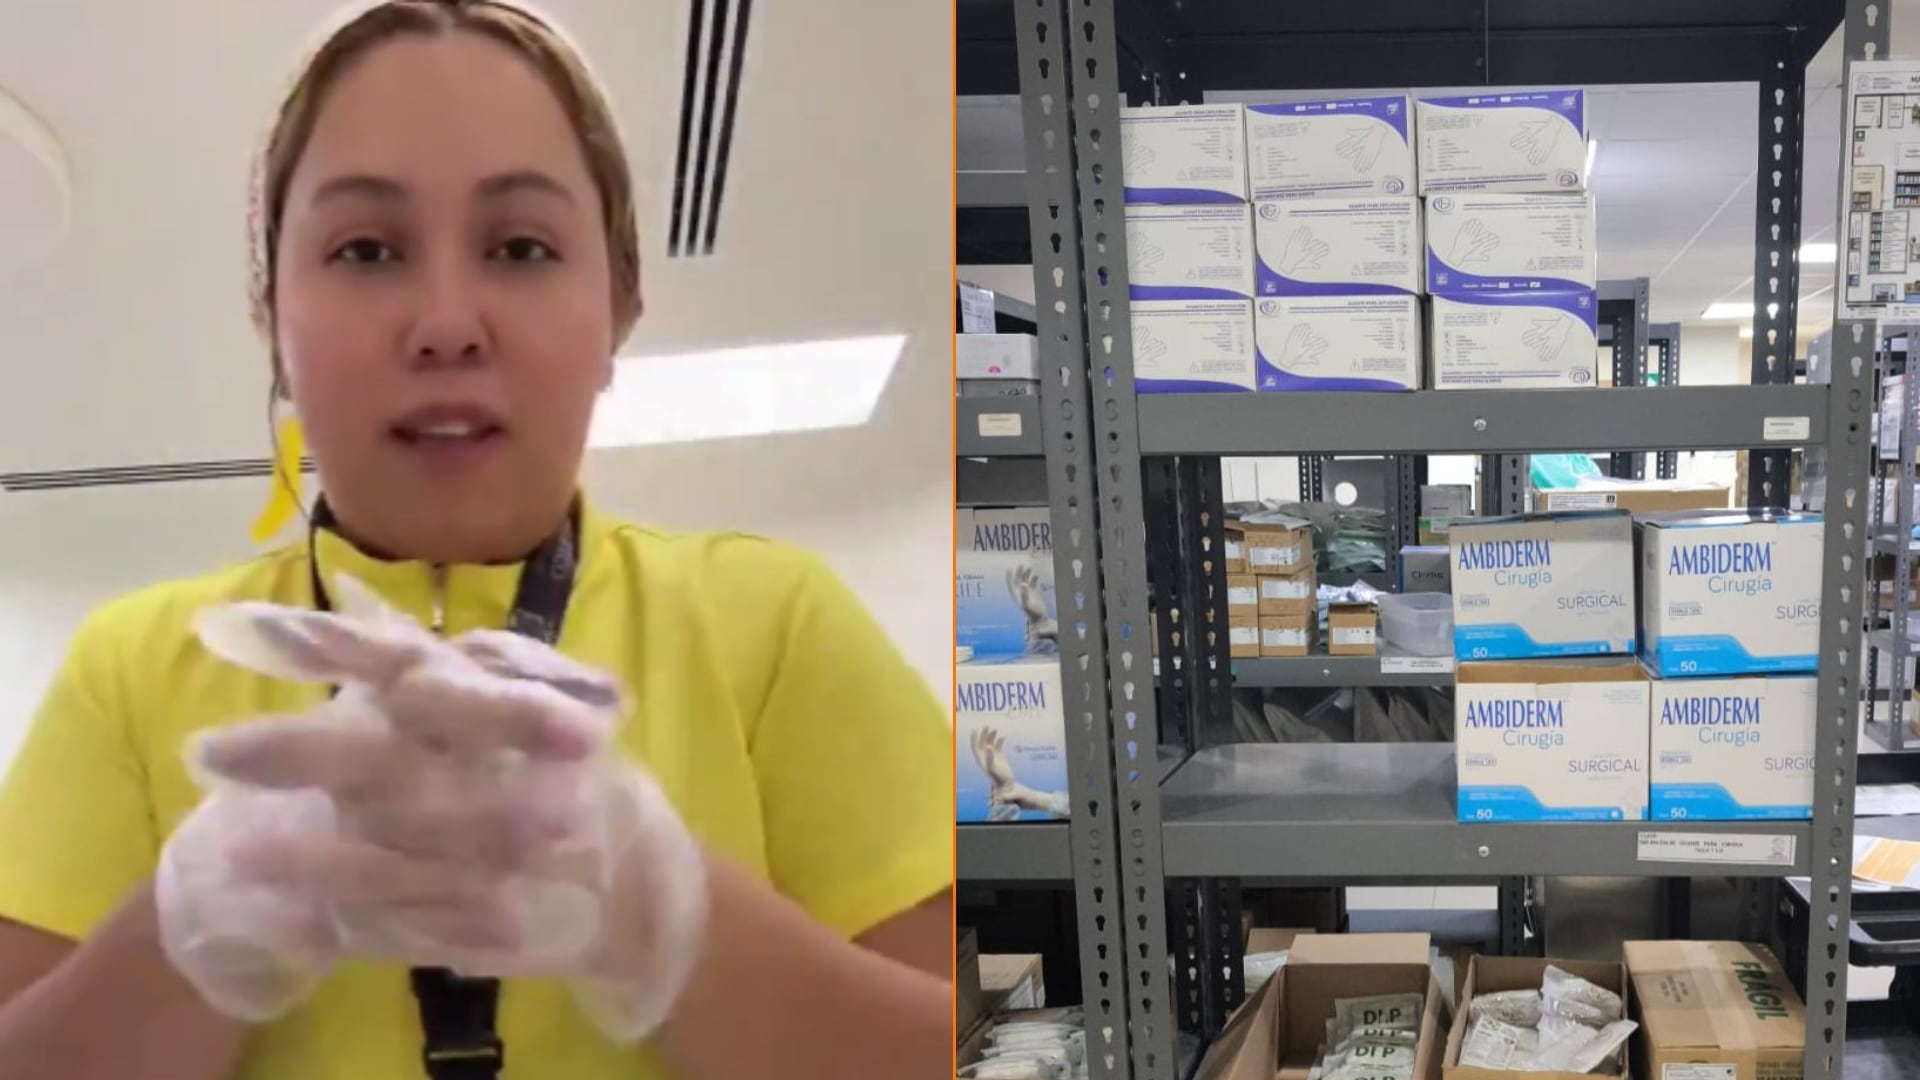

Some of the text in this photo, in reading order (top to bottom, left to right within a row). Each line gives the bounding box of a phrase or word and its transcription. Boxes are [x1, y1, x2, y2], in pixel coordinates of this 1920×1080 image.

[1458, 539, 1551, 570] AMBIDERM
[1668, 541, 1772, 576] AMBIDERM
[1557, 594, 1628, 610] SURGICAL
[1473, 647, 1488, 658] 50
[1681, 660, 1697, 672] 50
[1465, 699, 1563, 728] AMBIDERM
[1660, 696, 1761, 726] AMBIDERM
[1568, 759, 1641, 773] SURGICAL
[1476, 808, 1493, 819] 50
[1670, 808, 1687, 819] 50
